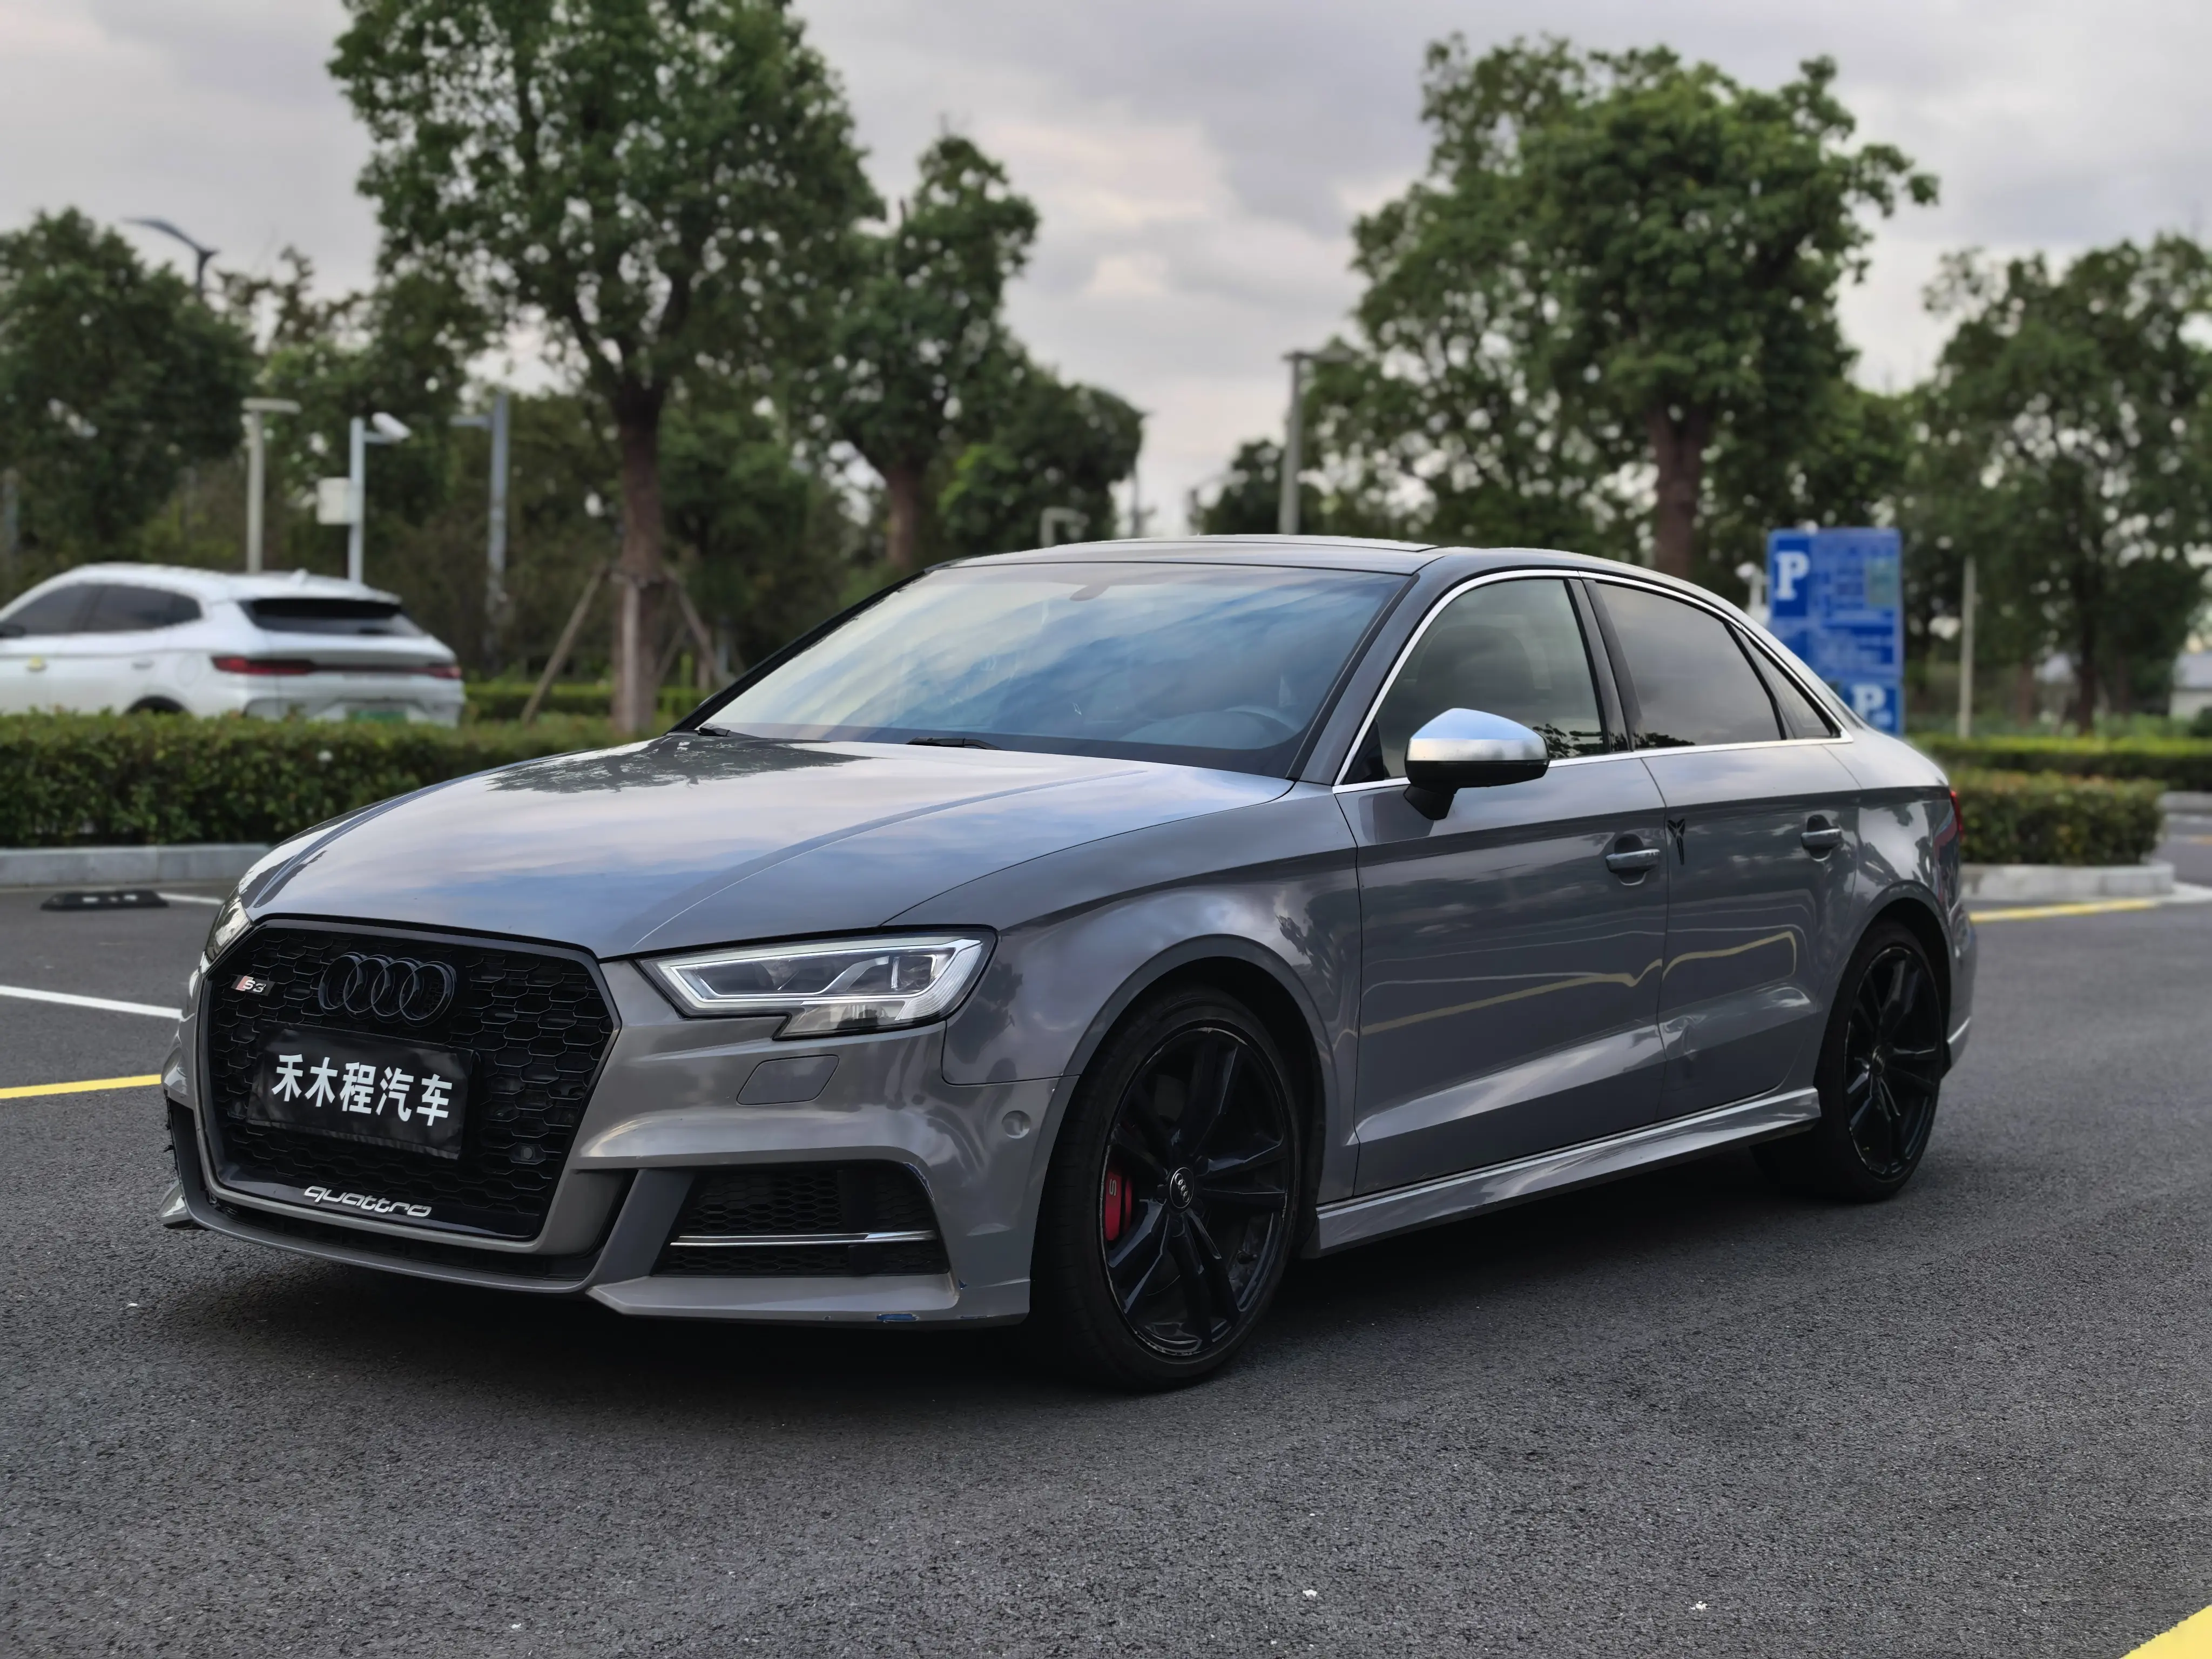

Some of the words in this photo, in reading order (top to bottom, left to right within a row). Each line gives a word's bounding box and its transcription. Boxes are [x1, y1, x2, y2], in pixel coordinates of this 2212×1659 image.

[1773, 551, 1809, 601] P
[242, 979, 267, 993] S3
[271, 1054, 453, 1127] 禾木程汽车
[304, 1185, 432, 1217] quattro
